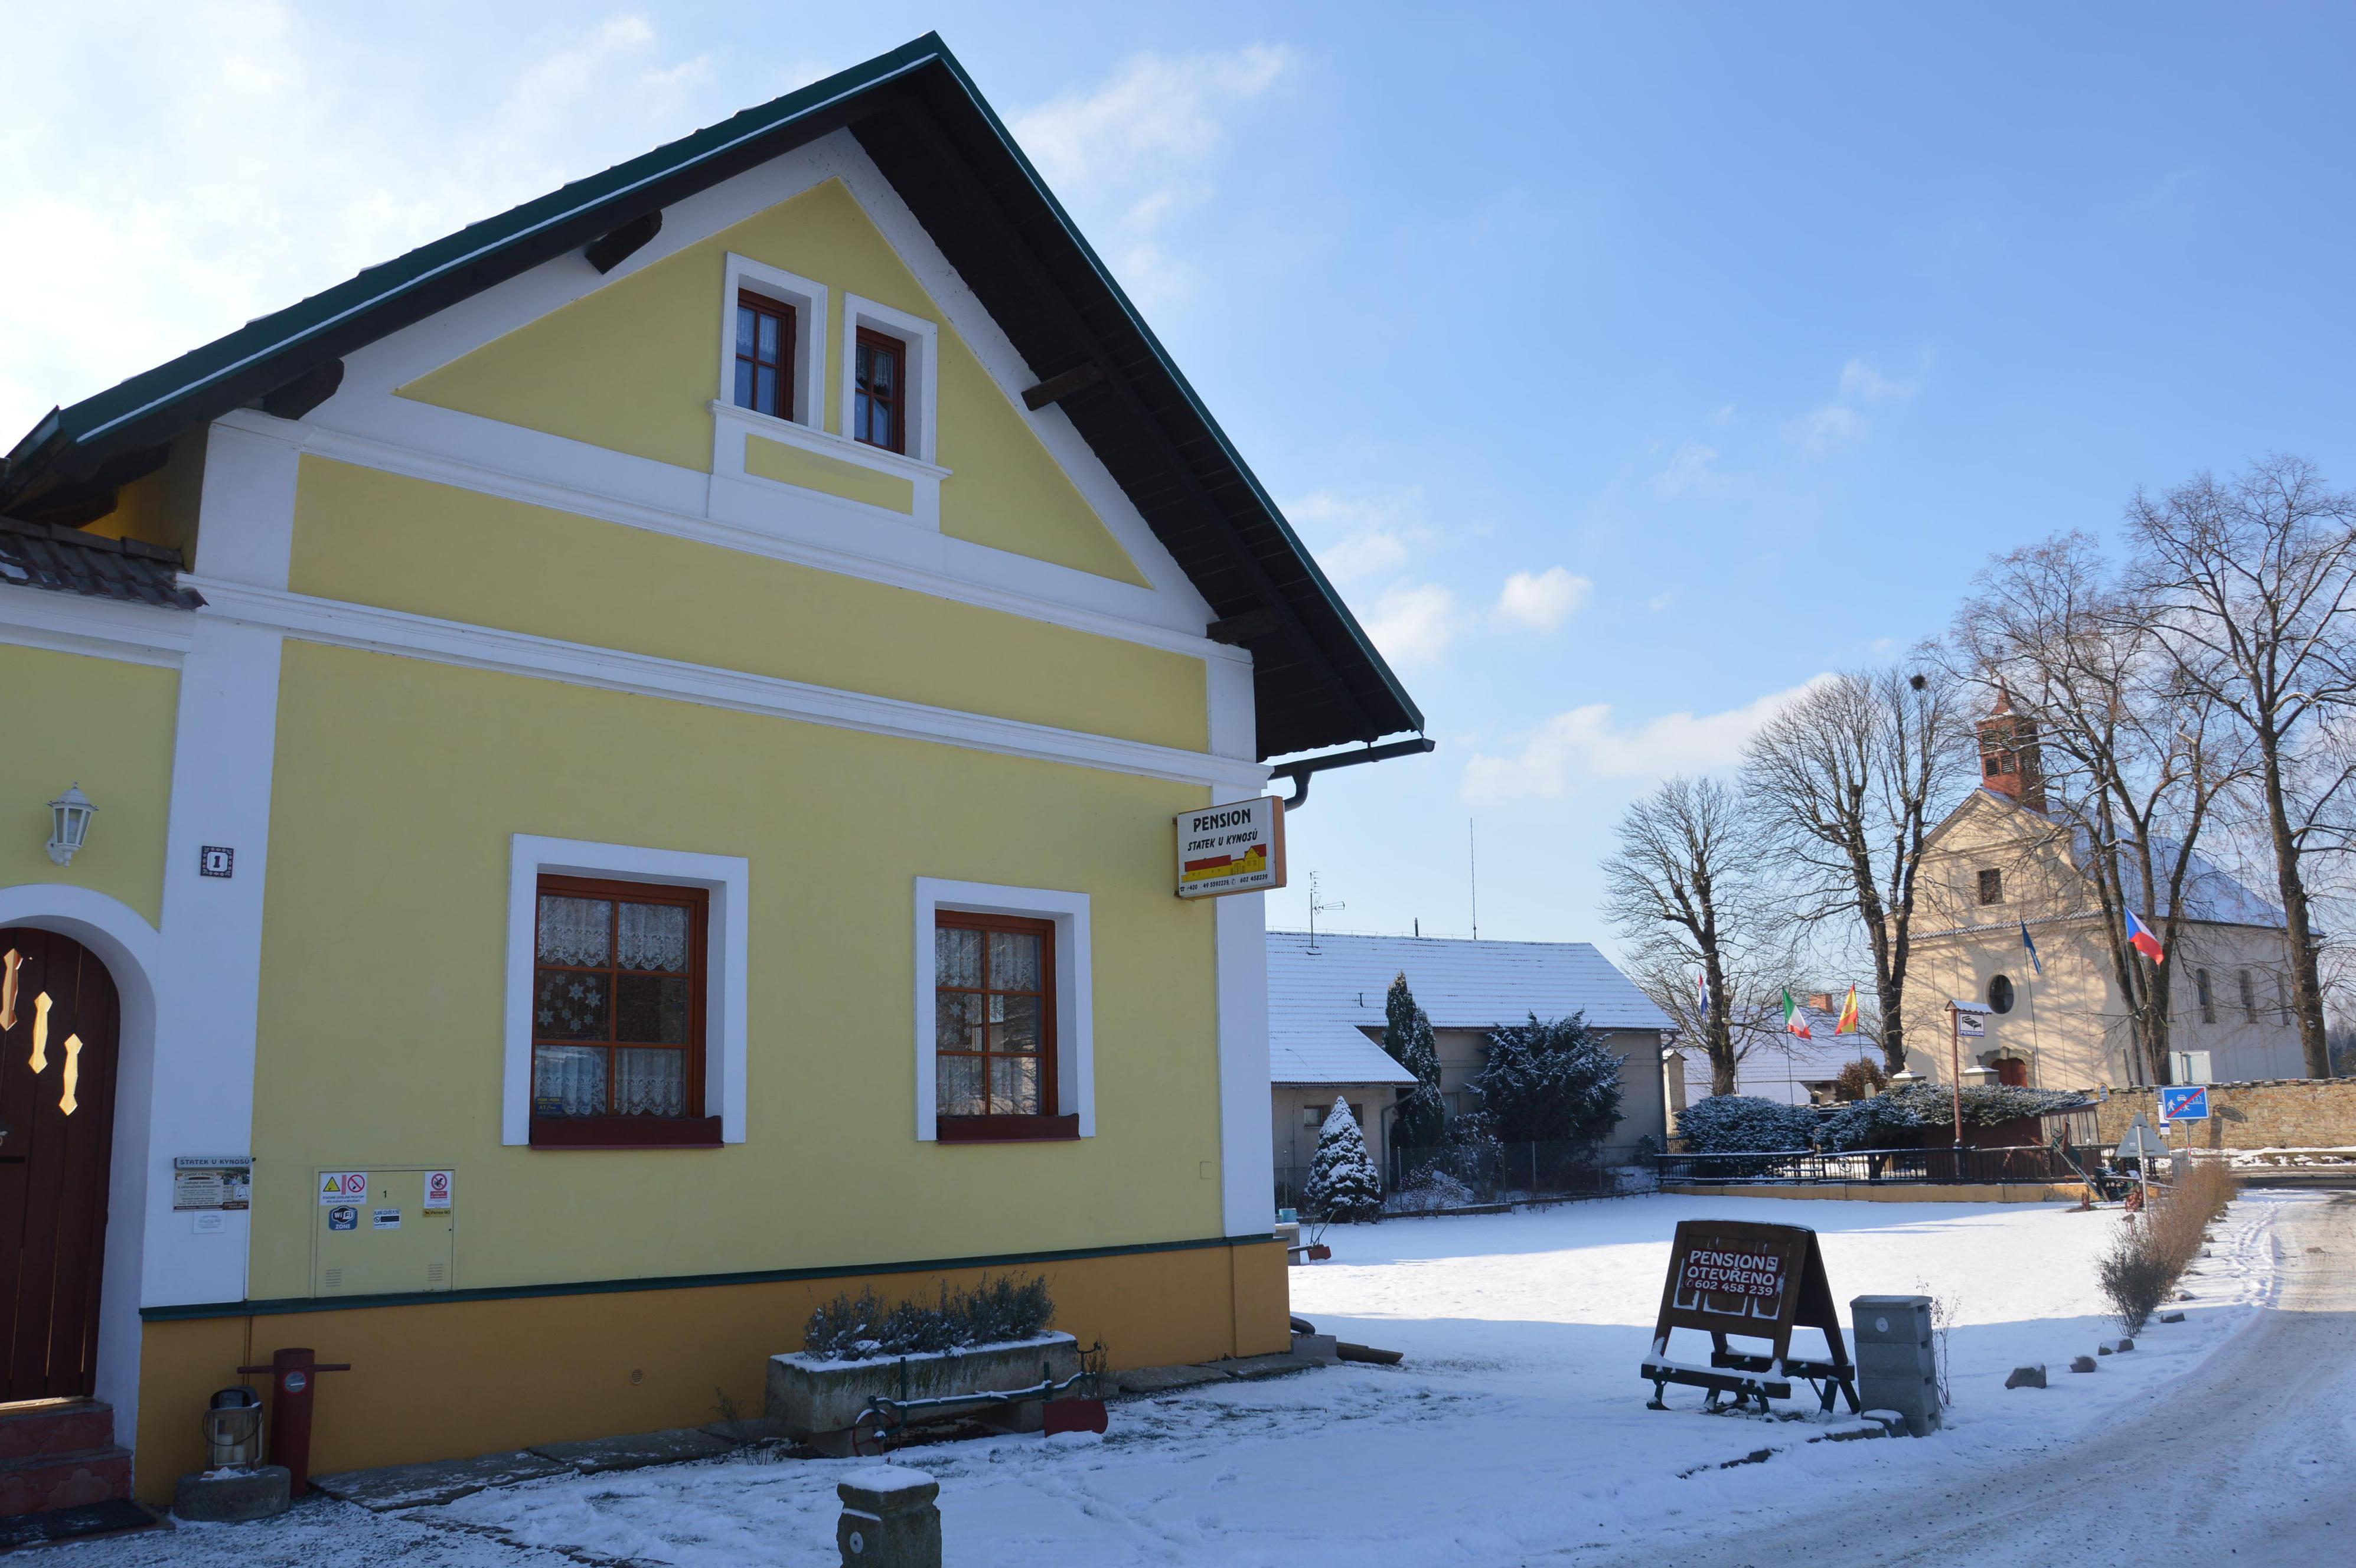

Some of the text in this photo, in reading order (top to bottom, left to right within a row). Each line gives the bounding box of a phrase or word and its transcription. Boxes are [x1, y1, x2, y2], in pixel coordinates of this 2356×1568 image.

[1193, 808, 1251, 832] PENSION
[1187, 828, 1258, 851] STATEK U KYNOSŮ
[213, 855, 220, 868] 1
[383, 1190, 387, 1198] 1
[1689, 1250, 1766, 1270] PENSION
[1687, 1265, 1774, 1286] OTEVŘENO
[1695, 1279, 1774, 1296] 602 458 239
